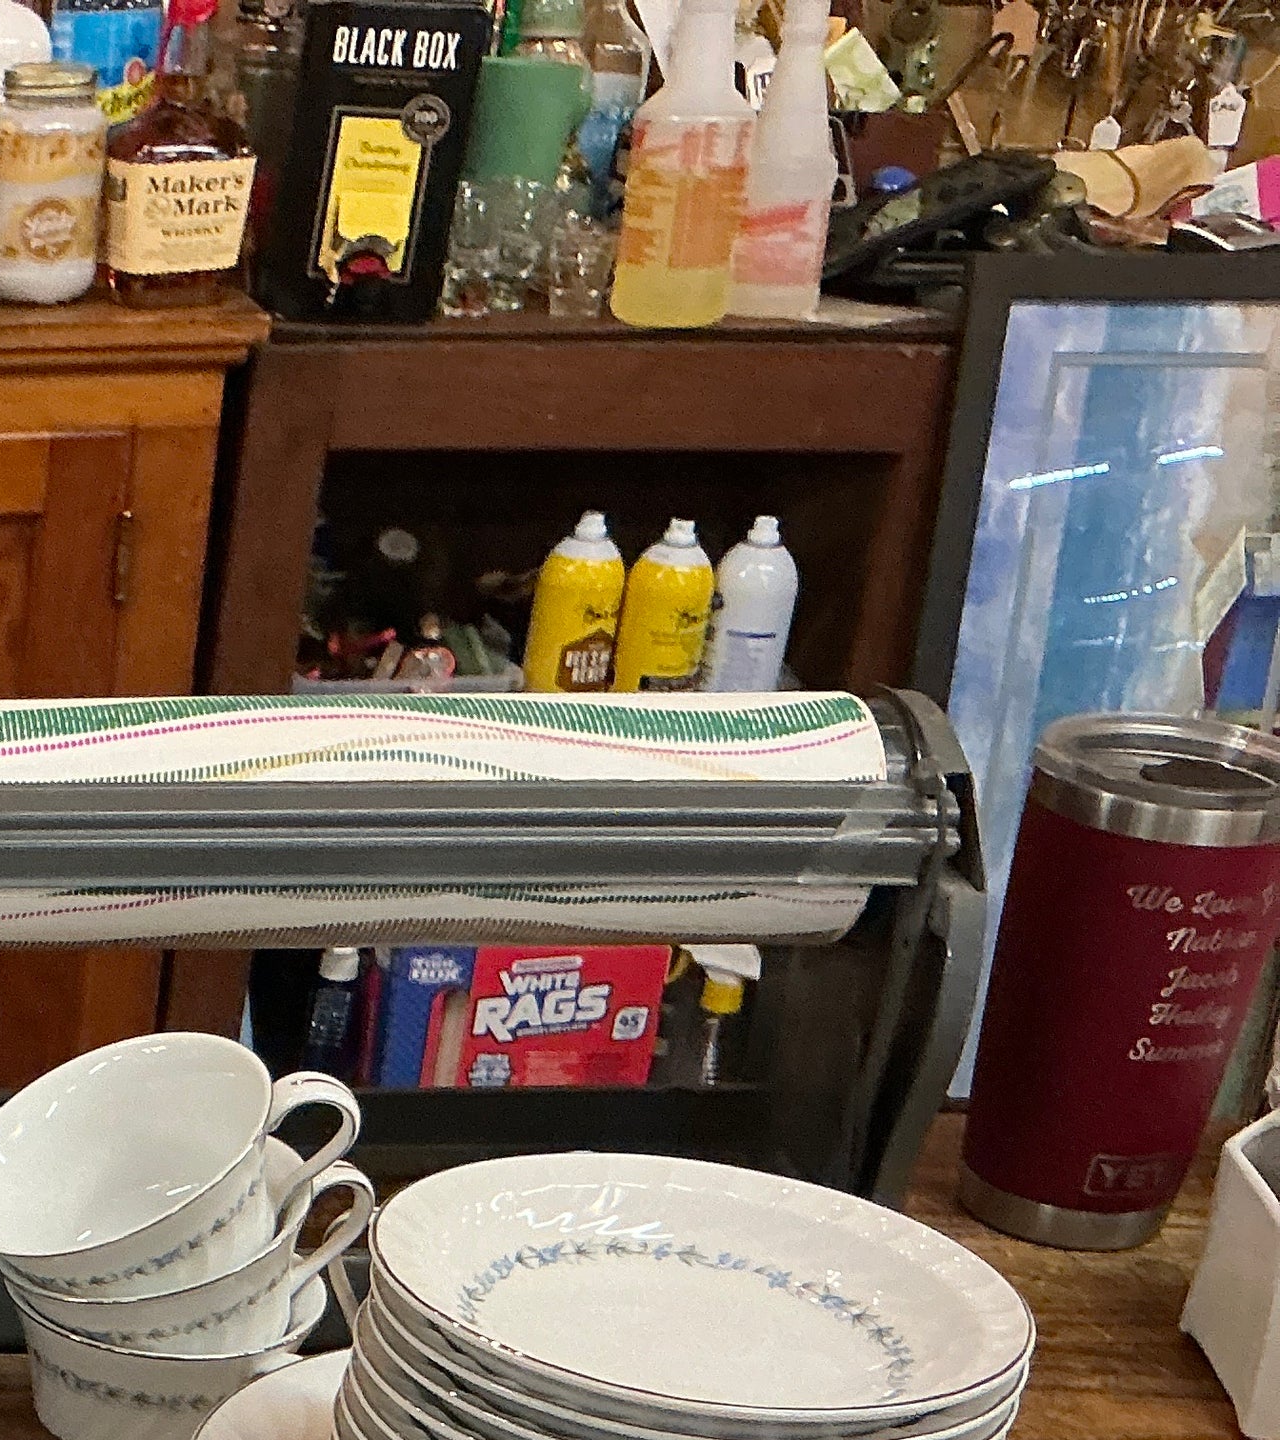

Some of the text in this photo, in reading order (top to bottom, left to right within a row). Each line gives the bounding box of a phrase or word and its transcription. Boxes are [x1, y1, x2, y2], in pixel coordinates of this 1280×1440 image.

[332, 25, 461, 71] BLACK BOX
[147, 174, 246, 194] Maker's
[173, 195, 240, 216] Mark
[1127, 883, 1184, 913] We
[499, 970, 581, 996] WHITE
[472, 984, 612, 1043] RAGS
